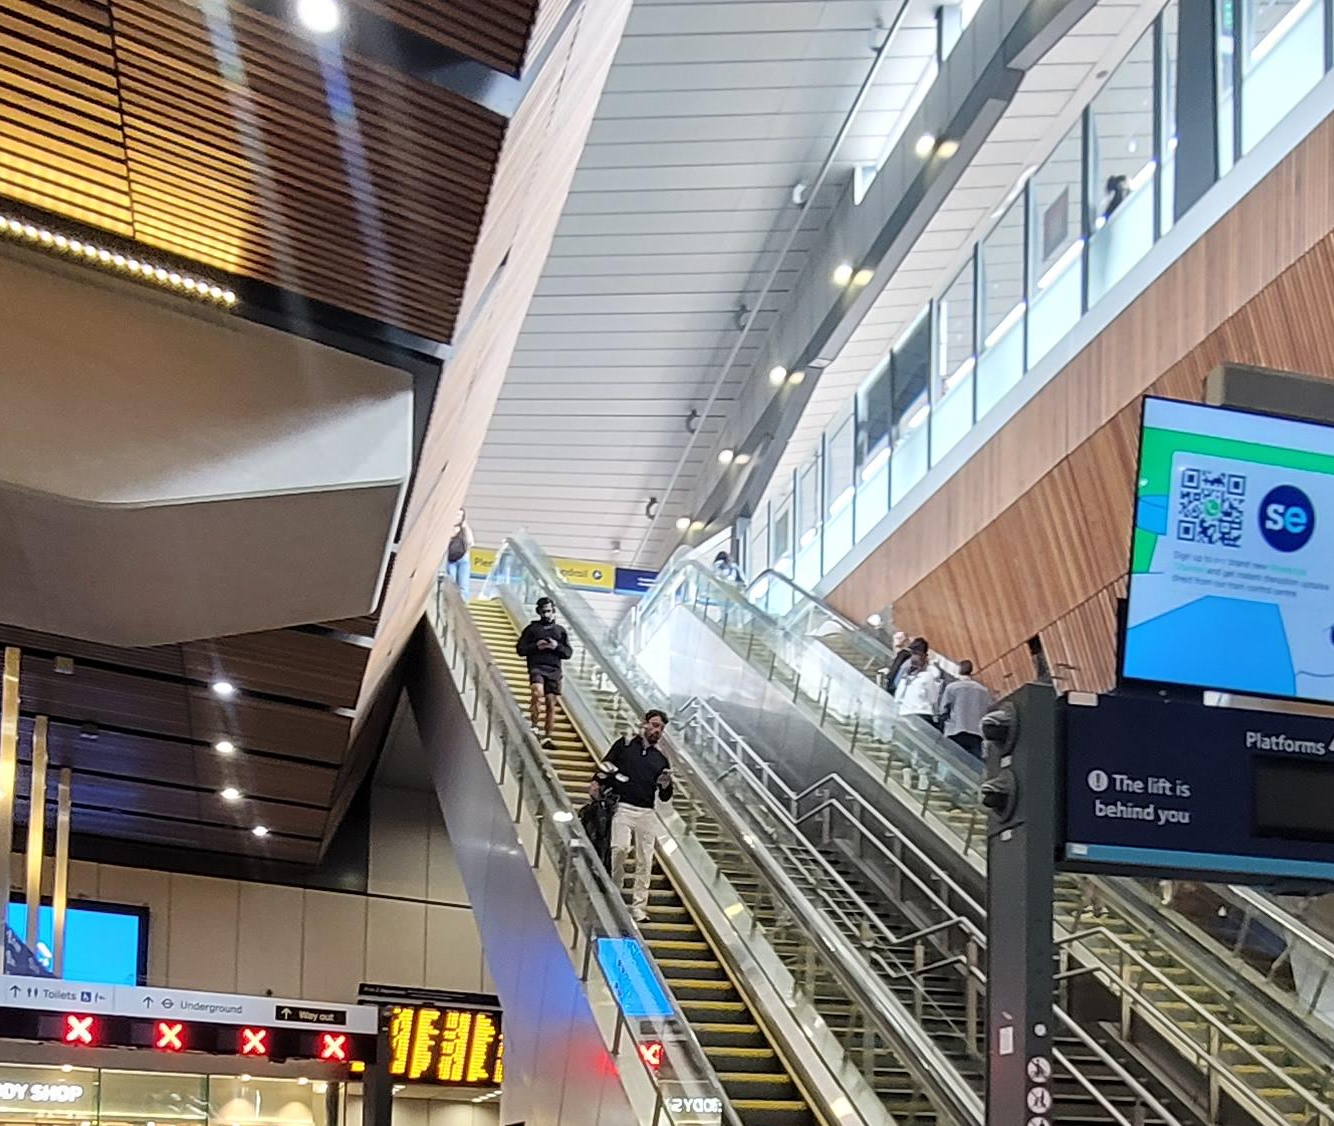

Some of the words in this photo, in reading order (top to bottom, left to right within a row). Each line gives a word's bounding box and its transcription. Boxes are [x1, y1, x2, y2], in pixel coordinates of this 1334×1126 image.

[1266, 497, 1307, 535] se
[1245, 731, 1326, 756] Platforms
[1112, 773, 1145, 794] The
[1147, 776, 1174, 796] lift
[1176, 780, 1191, 797] is
[1095, 799, 1155, 822] behind
[1157, 808, 1191, 825] you
[42, 988, 77, 1002] Toilets
[180, 1001, 243, 1015] Underground
[298, 1010, 319, 1022] Way
[319, 1011, 335, 1022] out
[30, 1084, 84, 1103] SHOP
